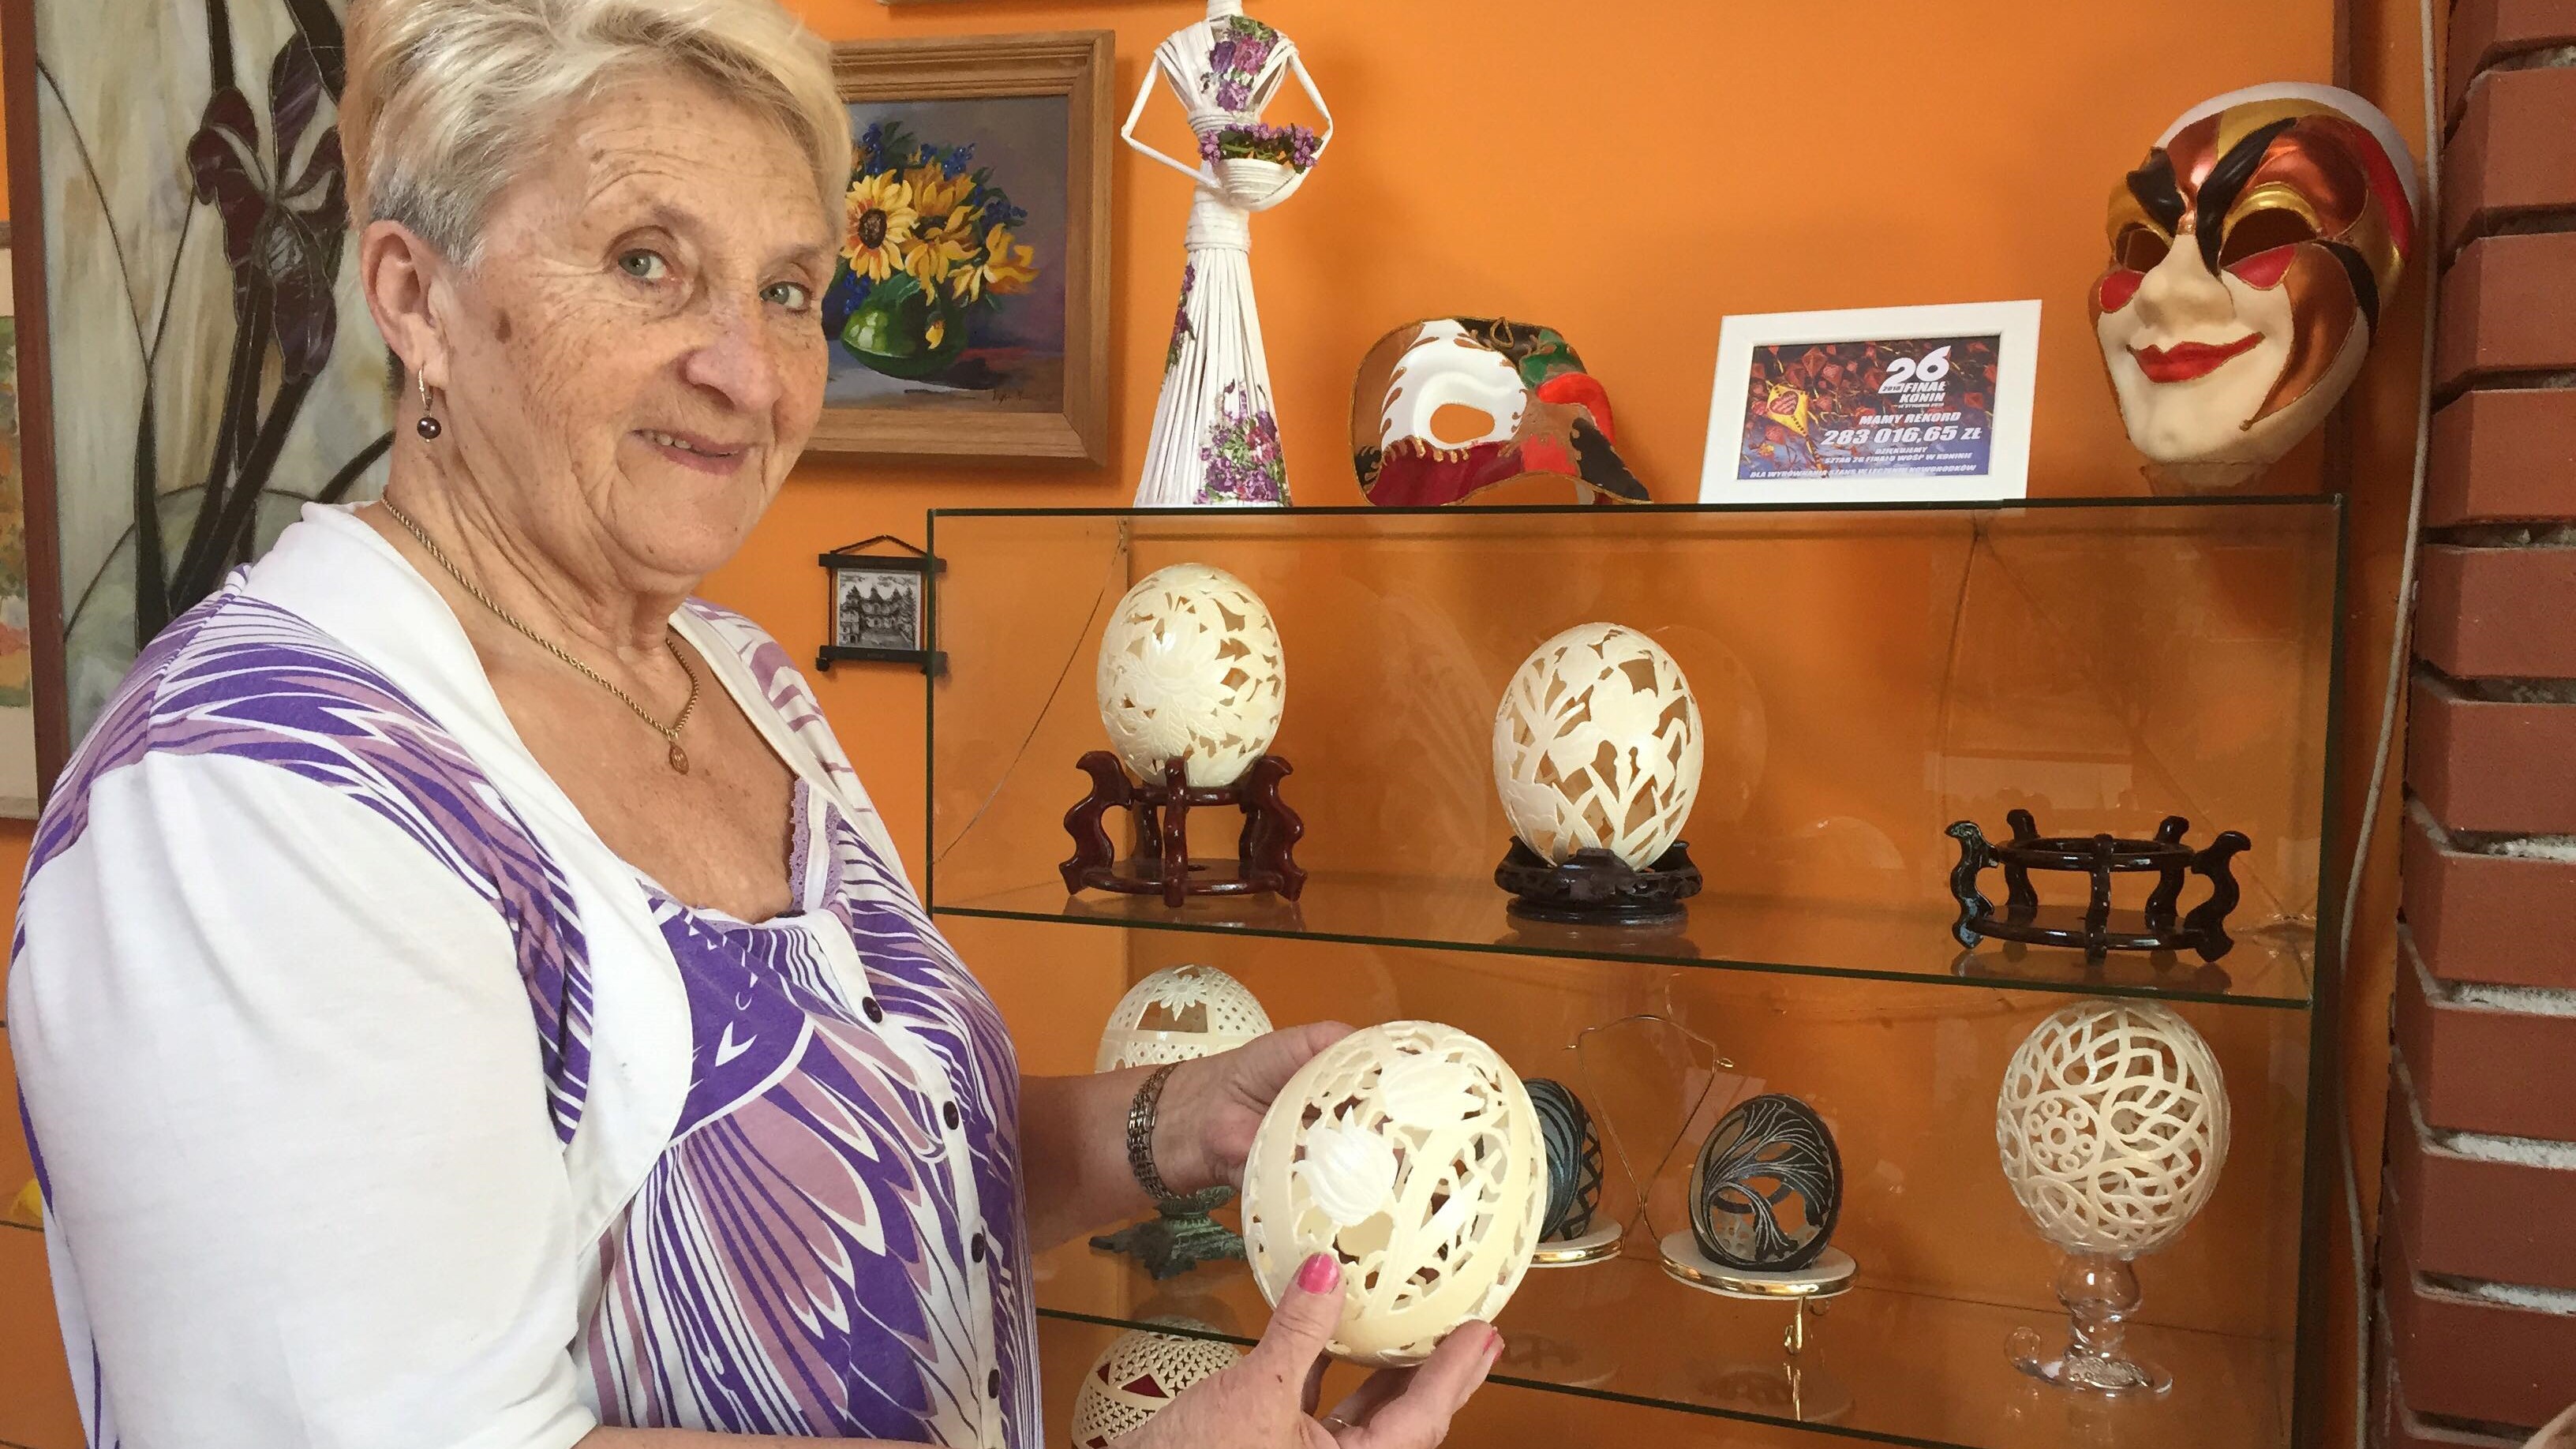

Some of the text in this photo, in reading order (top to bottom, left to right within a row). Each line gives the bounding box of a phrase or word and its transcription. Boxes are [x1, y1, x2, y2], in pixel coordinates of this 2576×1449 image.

[1878, 345, 1952, 394] 26
[1903, 381, 1946, 393] FINAŁ
[1899, 392, 1945, 403] KONIN
[1859, 412, 1961, 425] MAMY REKORD
[1821, 429, 1870, 445] 283
[1874, 425, 1958, 444] 016,65
